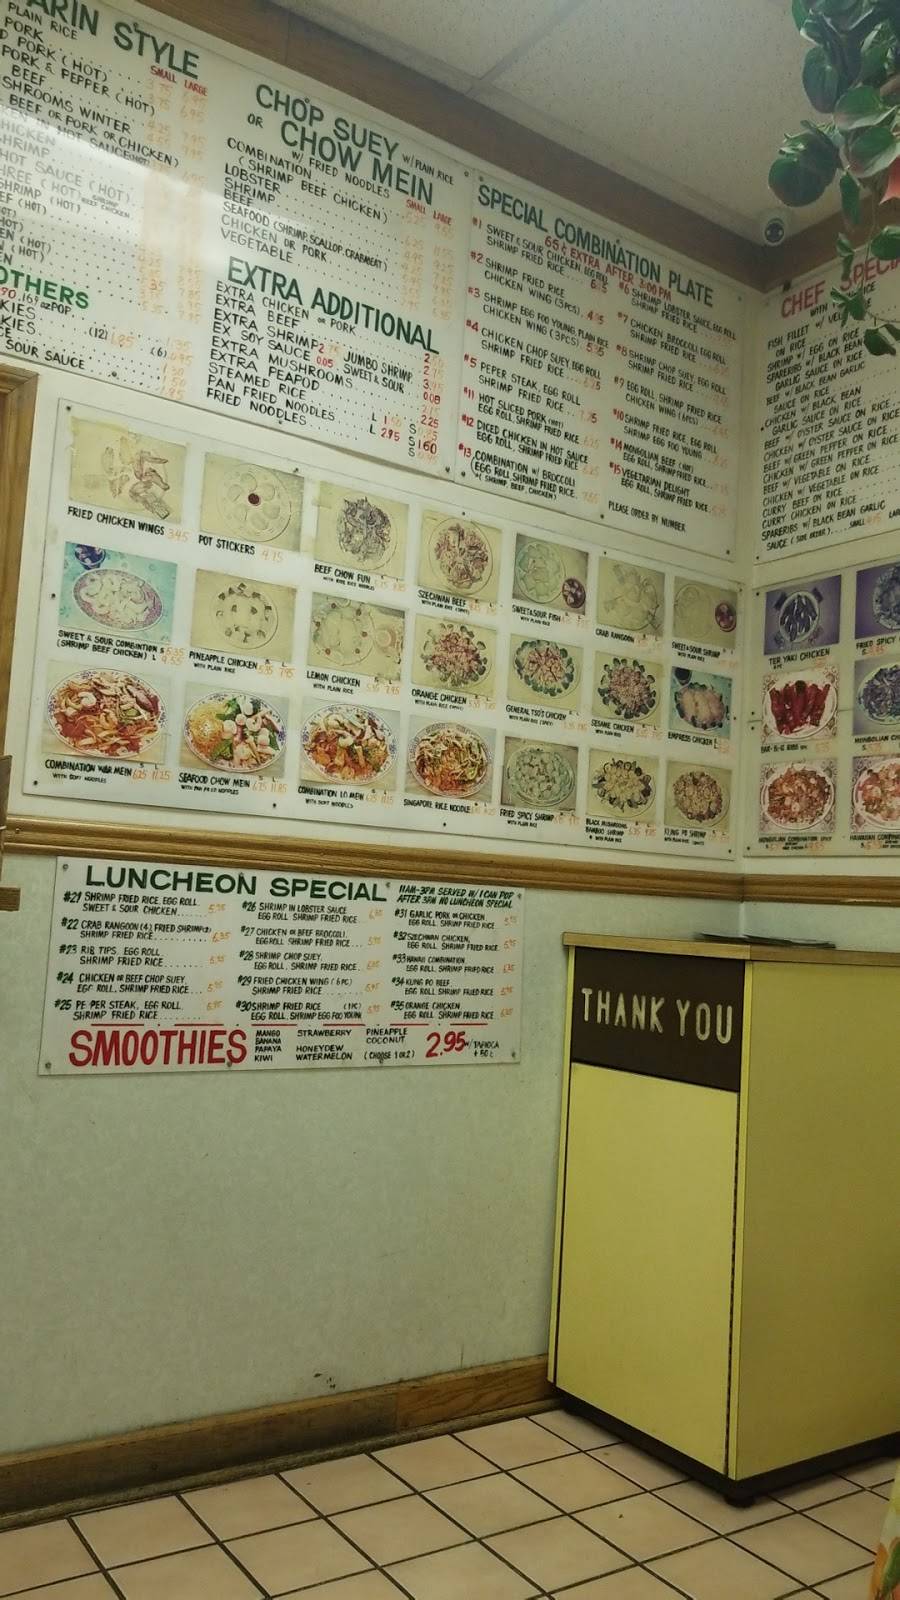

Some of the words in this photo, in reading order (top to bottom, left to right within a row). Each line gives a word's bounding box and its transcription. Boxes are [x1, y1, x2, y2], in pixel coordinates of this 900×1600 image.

[4, 17, 43, 43] PORK
[8, 2, 42, 25] PLAIN
[50, 20, 78, 40] RICE
[18, 36, 56, 60] PORK
[114, 22, 199, 79] STYLE
[11, 65, 47, 85] BEEF
[61, 69, 110, 98] PEPPER
[151, 66, 177, 83] SMALL
[184, 80, 208, 96] LARGE
[9, 94, 42, 114] BEEF
[66, 115, 97, 135] PORK
[79, 106, 132, 134] WINTER
[256, 84, 324, 126] CHOP
[333, 117, 399, 161] SUEY
[227, 137, 312, 180] COMBINATION
[247, 114, 264, 129] OR
[281, 120, 362, 173] CHOW
[372, 158, 433, 206] MEIN
[224, 177, 275, 204] SHRIMP
[225, 163, 281, 194] LOBSTER
[300, 181, 327, 198] BEEF
[309, 158, 338, 178] FRIED
[344, 173, 390, 198] NOODLES
[223, 201, 270, 228] SEAFOOD
[406, 200, 426, 215] SMALL
[220, 228, 294, 263] VEGETABLE
[221, 214, 277, 244] CHICKEN
[302, 244, 327, 263] PORK
[478, 185, 548, 233] SPECIAL
[555, 218, 660, 283] COMBINATION
[669, 270, 713, 307] PLATE
[487, 224, 514, 242] SWEET
[547, 251, 580, 272] CHICKEN
[521, 250, 543, 265] FRIED
[485, 258, 518, 277] SHRIMP
[522, 273, 545, 289] FRIED
[548, 284, 565, 298] RICE
[485, 271, 523, 292] CHICKEN
[528, 287, 552, 304] WING
[570, 248, 600, 270] EXTRA
[605, 264, 634, 284] AFTER
[659, 288, 672, 301] PM
[215, 294, 256, 316] EXTRA
[267, 310, 300, 329] BEEF
[216, 280, 254, 302] EXTRA
[262, 296, 309, 319] CHICKEN
[228, 256, 303, 306] EXTRA
[311, 287, 439, 355] ADDITIONAL
[781, 280, 826, 318] CHEF
[6, 339, 39, 358] SOUR
[45, 351, 85, 370] SAUCE
[214, 309, 258, 330] EXTRA
[266, 326, 319, 349] SHRIMP
[344, 352, 378, 371] JUMBO
[241, 329, 263, 344] SOY
[267, 339, 310, 361] SAUCE
[210, 349, 258, 371] EXTRA
[268, 366, 320, 391] PEAPOD
[212, 336, 259, 359] EXTRA
[268, 354, 352, 388] MUSHROOMS
[208, 362, 270, 388] STEAMED
[279, 381, 306, 398] RICE
[478, 375, 513, 393] SHRIMP
[518, 389, 541, 404] FRIED
[546, 398, 564, 412] RICE
[206, 388, 241, 407] FRIED
[250, 402, 306, 426] NOODLES
[208, 375, 235, 393] PAN
[243, 386, 277, 404] FRIED
[286, 396, 335, 420] NOODLES
[477, 420, 499, 434] DICED
[502, 429, 537, 447] CHICKEN
[567, 450, 589, 464] SAUCE
[475, 450, 528, 474] COMBINATION
[67, 506, 93, 520] FRIED
[96, 513, 135, 529] CHICKEN
[137, 521, 165, 535] WINGS
[608, 501, 628, 515] PLEASE
[198, 534, 213, 545] POT
[215, 538, 255, 555] STICKERS
[314, 564, 332, 574] BEEF
[334, 569, 354, 580] CHOW
[357, 574, 371, 583] FUN
[452, 598, 466, 607] BEEF
[58, 630, 86, 641] SWEET
[94, 635, 114, 646] SOUR
[92, 645, 111, 653] BEEF
[189, 651, 225, 664] PINEAPPLE
[227, 658, 258, 669] CHICKEN
[800, 649, 830, 661] CHICKEN
[306, 671, 329, 681] LEMON
[332, 675, 360, 687] CHICKEN
[412, 689, 438, 700] ORANGE
[440, 693, 467, 704] CHICKEN
[45, 759, 96, 772] COMBINATION
[113, 766, 132, 777] MEIN
[179, 773, 209, 785] SEAFOOD
[210, 777, 230, 786] CHOW
[232, 779, 250, 788] MEIN
[86, 865, 256, 896] LUNCHEON
[270, 878, 387, 902] SPECIAL
[82, 904, 109, 912] SWEET
[119, 904, 139, 913] SOUR
[259, 903, 287, 911] SHRIMP
[297, 905, 325, 913] LOBSTER
[61, 918, 79, 929] #22
[81, 920, 102, 929] CRAB
[56, 973, 74, 984] #24
[79, 974, 114, 983] CHICKEN
[125, 975, 143, 983] BEEF
[254, 976, 273, 984] FRIED
[276, 977, 307, 985] CHICKEN
[581, 987, 664, 1034] THANK
[676, 999, 733, 1044] YOU
[366, 1028, 407, 1036] PINEAPPLE
[367, 1036, 405, 1044] COCONUT
[425, 1031, 465, 1058] 2.95
[69, 1030, 247, 1067] SMOOTHIES
